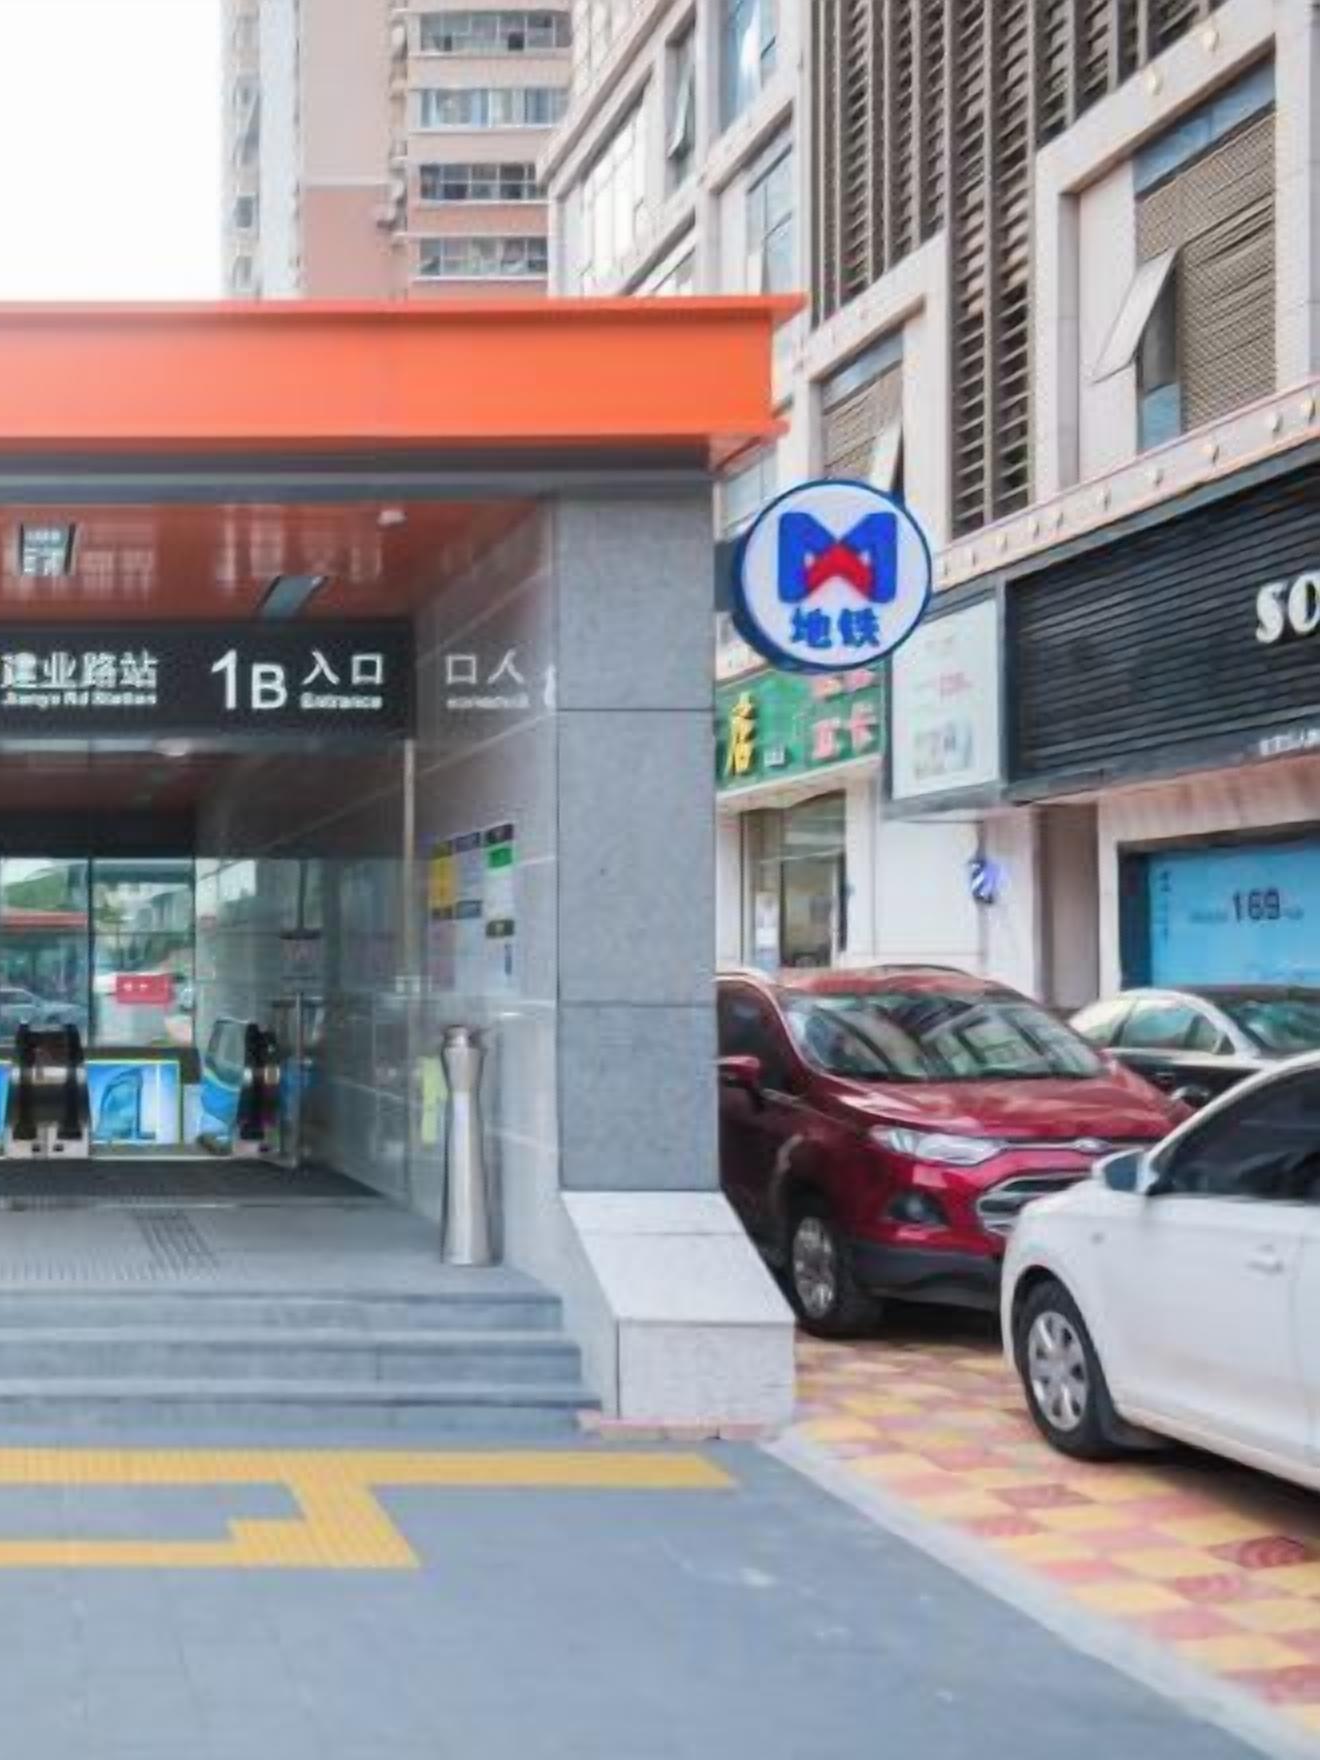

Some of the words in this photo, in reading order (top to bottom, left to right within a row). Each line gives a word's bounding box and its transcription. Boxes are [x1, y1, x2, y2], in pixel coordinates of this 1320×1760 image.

[791, 607, 880, 649] 地铁
[0, 650, 158, 688] 建业路站
[211, 649, 288, 710] 1B
[302, 650, 383, 685] 入口
[300, 691, 383, 709] Entrance
